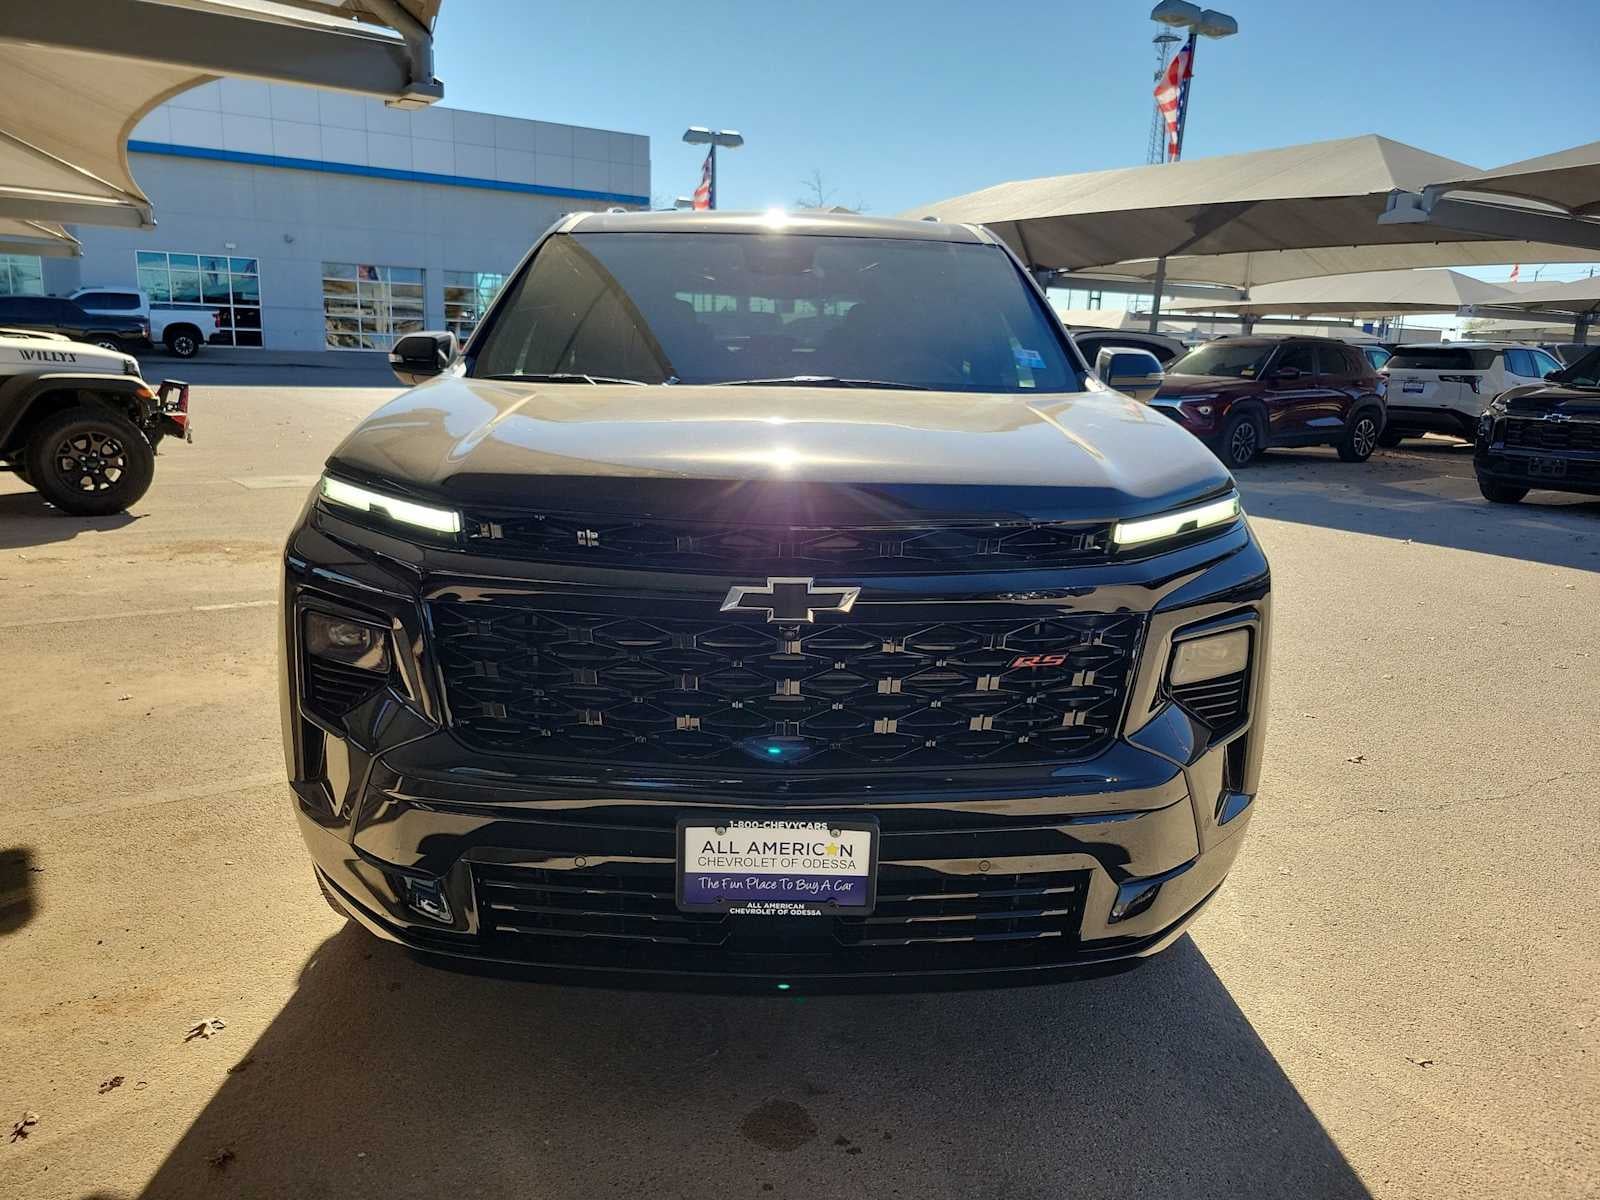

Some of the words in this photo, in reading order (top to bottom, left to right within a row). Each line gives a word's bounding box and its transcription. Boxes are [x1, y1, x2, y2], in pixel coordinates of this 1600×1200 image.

[19, 350, 78, 363] WILLYS
[1010, 654, 1066, 667] RS
[729, 820, 828, 830] 1-800-CHEVYCARS
[702, 841, 739, 854] ALL
[697, 856, 777, 868] CHEVROLET
[780, 857, 799, 869] OF
[802, 858, 857, 870] ODESSA
[698, 877, 720, 890] The
[722, 878, 744, 889] Fun
[745, 877, 778, 890] Place
[779, 878, 794, 890] To
[796, 879, 819, 895] Buy
[820, 880, 832, 891] A
[834, 880, 855, 892] Car
